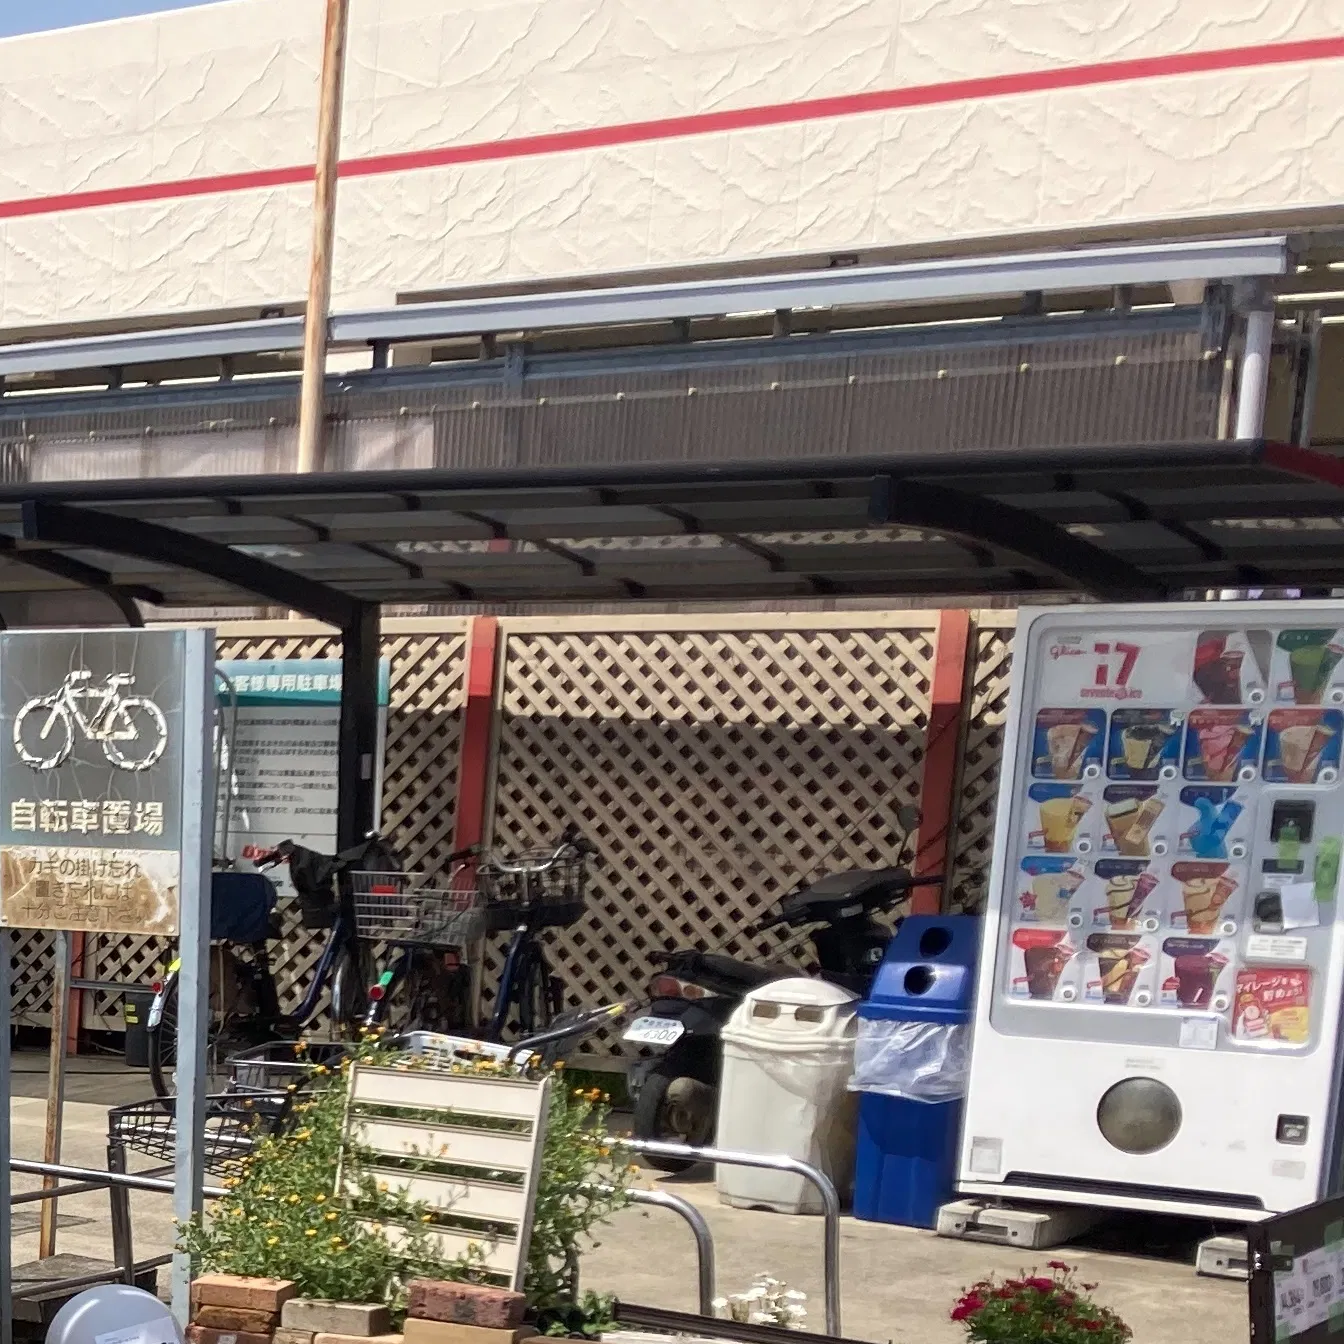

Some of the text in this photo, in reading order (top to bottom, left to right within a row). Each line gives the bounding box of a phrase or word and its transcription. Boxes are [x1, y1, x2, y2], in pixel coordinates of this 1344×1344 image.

[9, 799, 165, 837] 自転車置場
